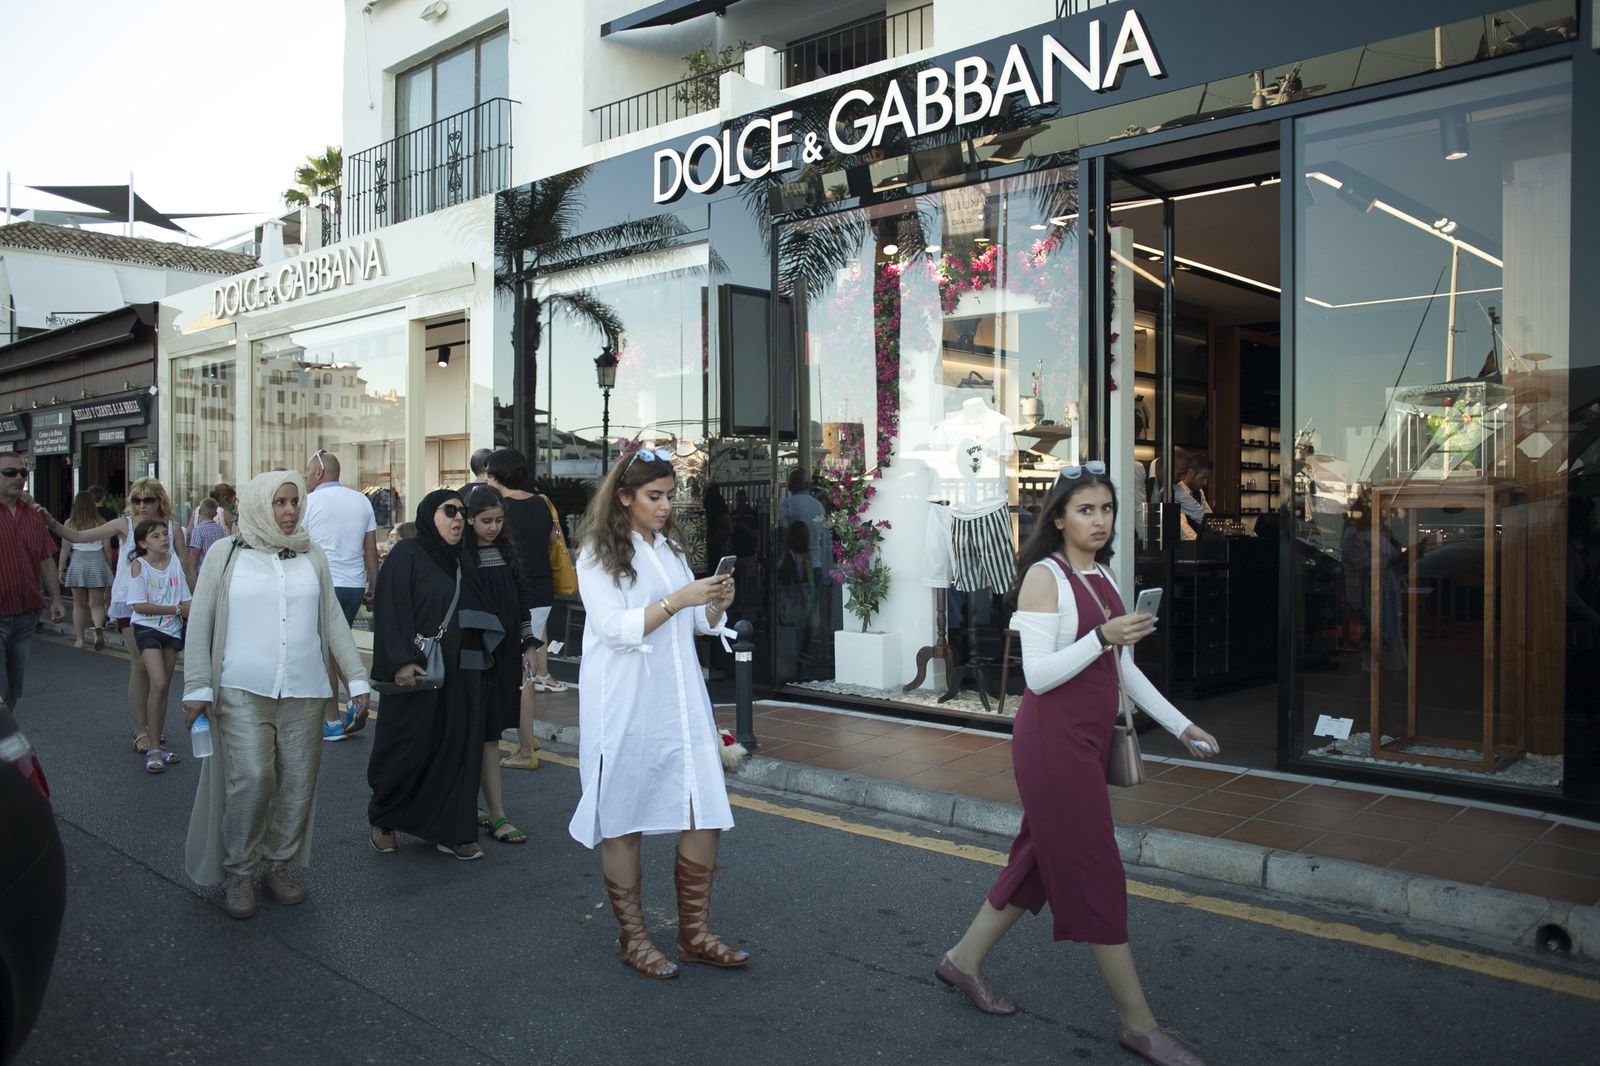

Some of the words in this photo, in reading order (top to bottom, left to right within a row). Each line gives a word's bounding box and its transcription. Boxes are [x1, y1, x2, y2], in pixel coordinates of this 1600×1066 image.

[653, 110, 796, 204] DOLCE
[802, 131, 824, 165] &
[828, 9, 1164, 155] GABBANA
[213, 272, 269, 319] DOLCE
[267, 285, 277, 306] &
[277, 238, 386, 302] GABBANA
